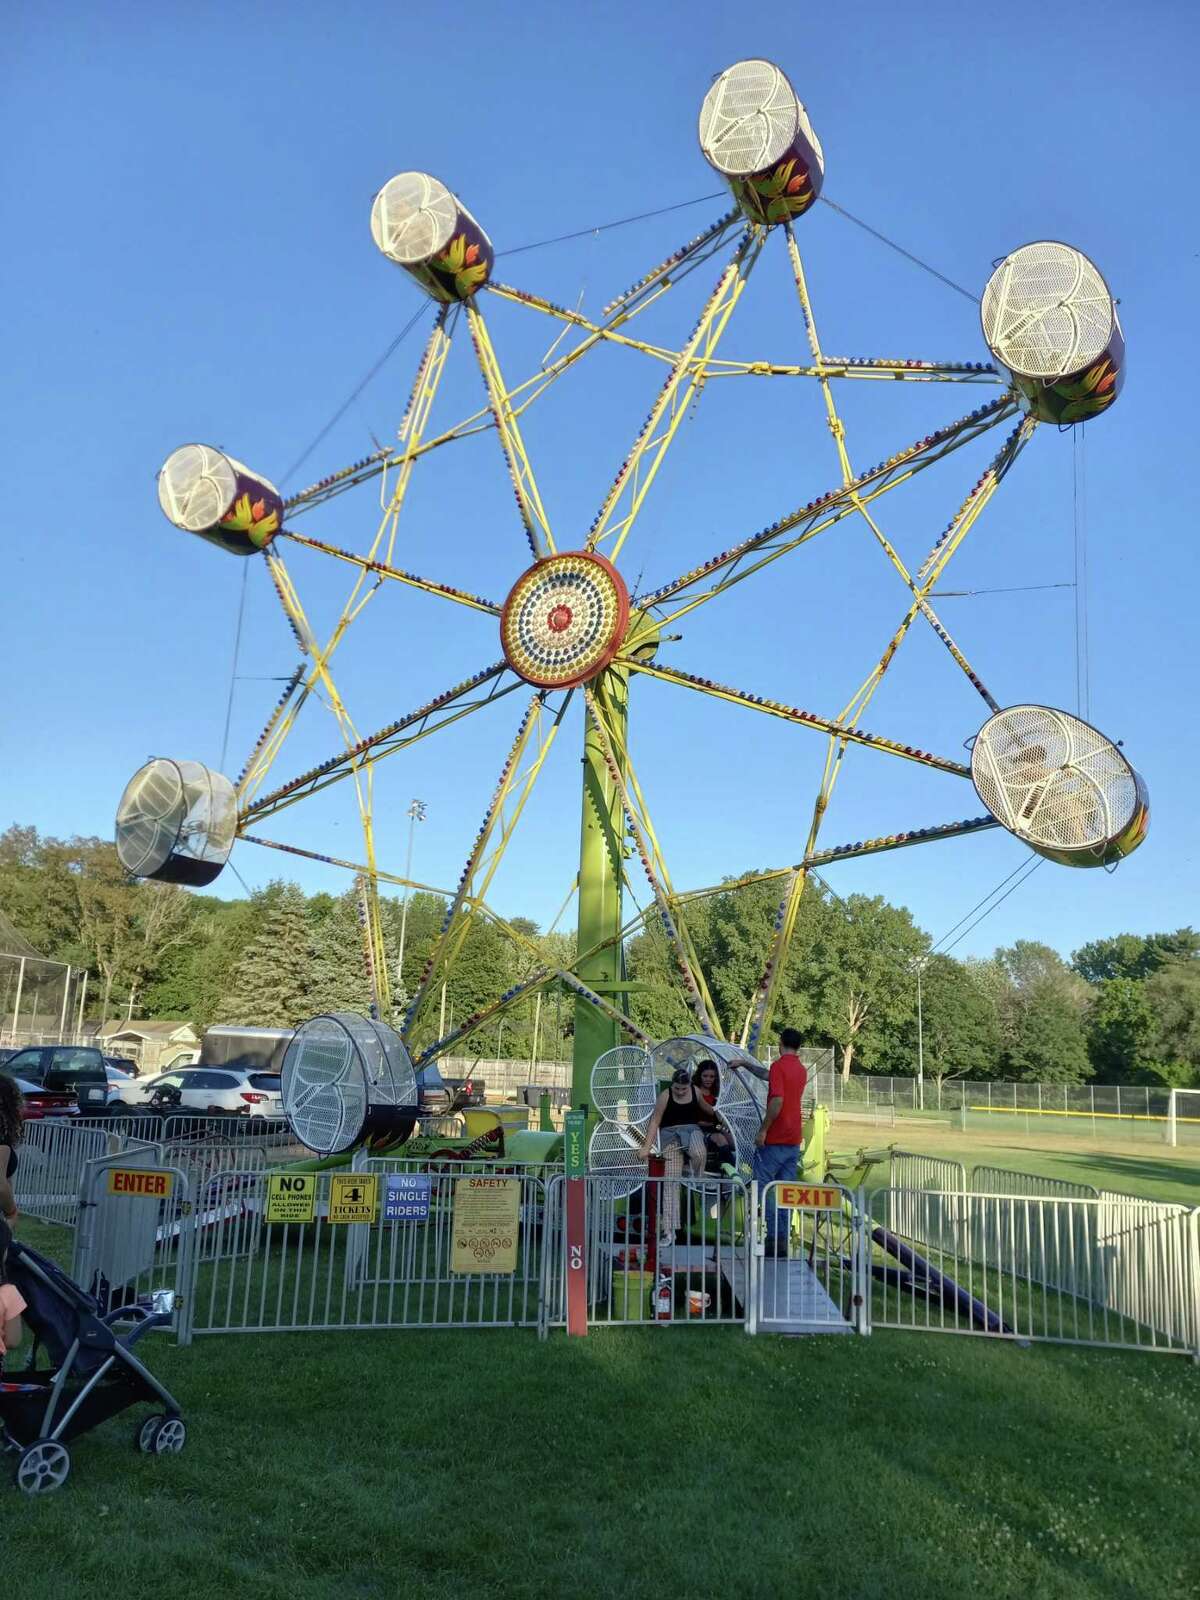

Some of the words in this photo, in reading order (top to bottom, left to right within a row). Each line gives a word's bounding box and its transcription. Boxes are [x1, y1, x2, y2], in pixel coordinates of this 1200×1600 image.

[570, 1132, 580, 1168] YES
[113, 1173, 166, 1194] ENTER
[280, 1177, 305, 1191] NO
[401, 1178, 416, 1188] NO
[469, 1179, 508, 1187] SAFETY
[344, 1188, 362, 1201] 4
[388, 1191, 428, 1201] SINGLE
[782, 1188, 834, 1206] EXIT
[333, 1206, 371, 1214] TICKETS
[386, 1206, 428, 1216] RIDERS
[570, 1245, 583, 1270] NO
